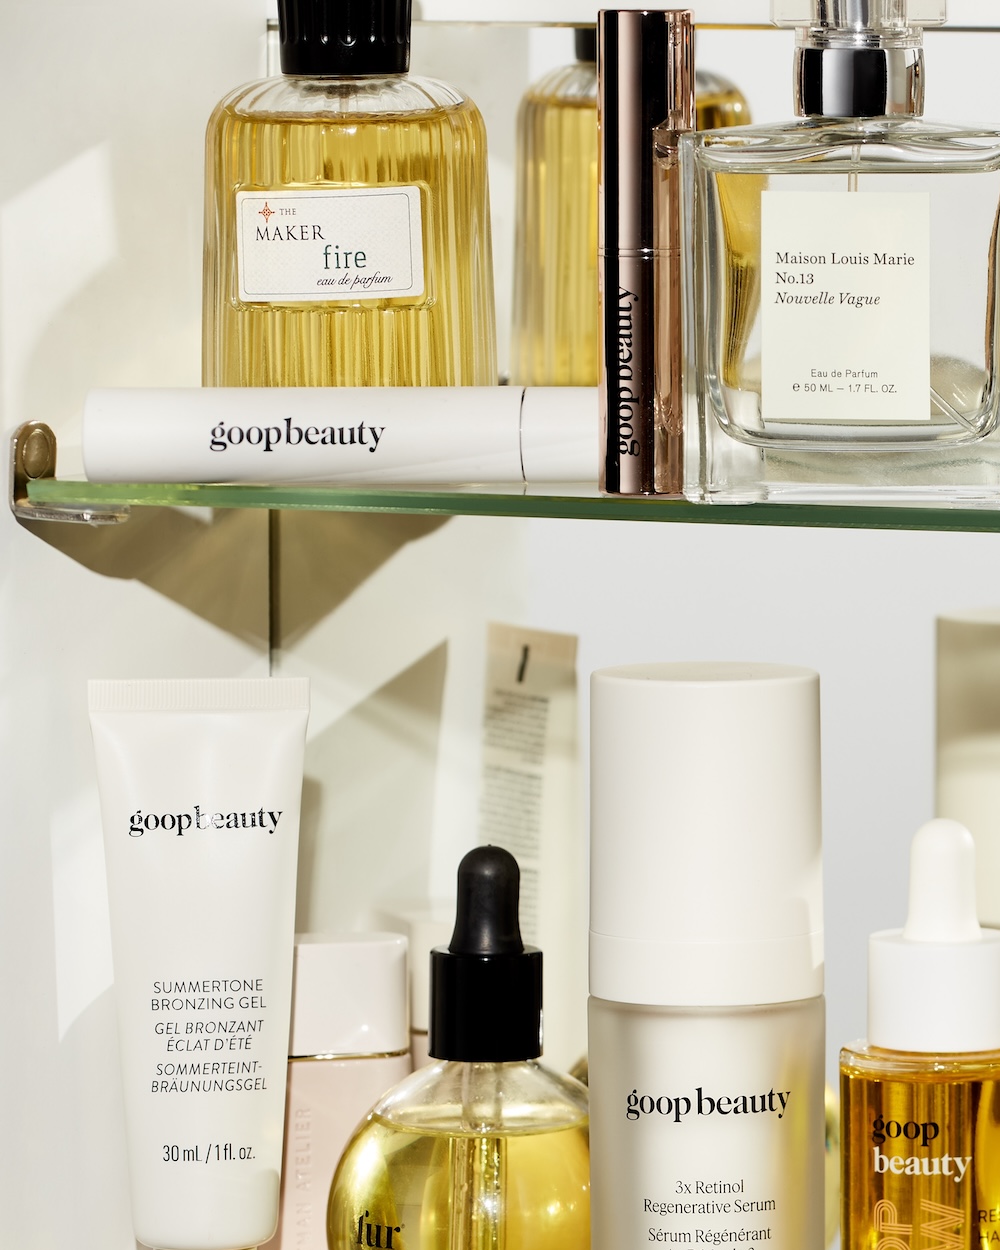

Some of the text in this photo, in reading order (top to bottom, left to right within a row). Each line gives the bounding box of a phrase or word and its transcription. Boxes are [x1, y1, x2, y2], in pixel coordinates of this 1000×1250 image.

[279, 208, 296, 216] THE
[256, 225, 326, 241] MAKER
[323, 245, 367, 270] fire
[775, 252, 915, 265] Maison Louis Marie
[317, 271, 393, 290] eau de parfum
[775, 272, 814, 285] No.13
[774, 292, 881, 308] Nouvelle Vague
[810, 369, 879, 378] Eau de Parfum
[153, 979, 263, 994] SUMMERTONE
[151, 996, 267, 1011] BRONZING GEL
[154, 1019, 265, 1035] GEL BRONZANT
[166, 1037, 210, 1052] ÉCLAT
[156, 1061, 263, 1076] SOMMERTEINT-
[151, 1077, 267, 1093] BRÄUNUNGSGEL
[871, 1114, 940, 1147] goop
[873, 1146, 972, 1183] beauty
[675, 1179, 744, 1195] 3x Retinol
[643, 1198, 776, 1216] Regenerative Serum
[648, 1227, 772, 1246] Sérum Régénérant
